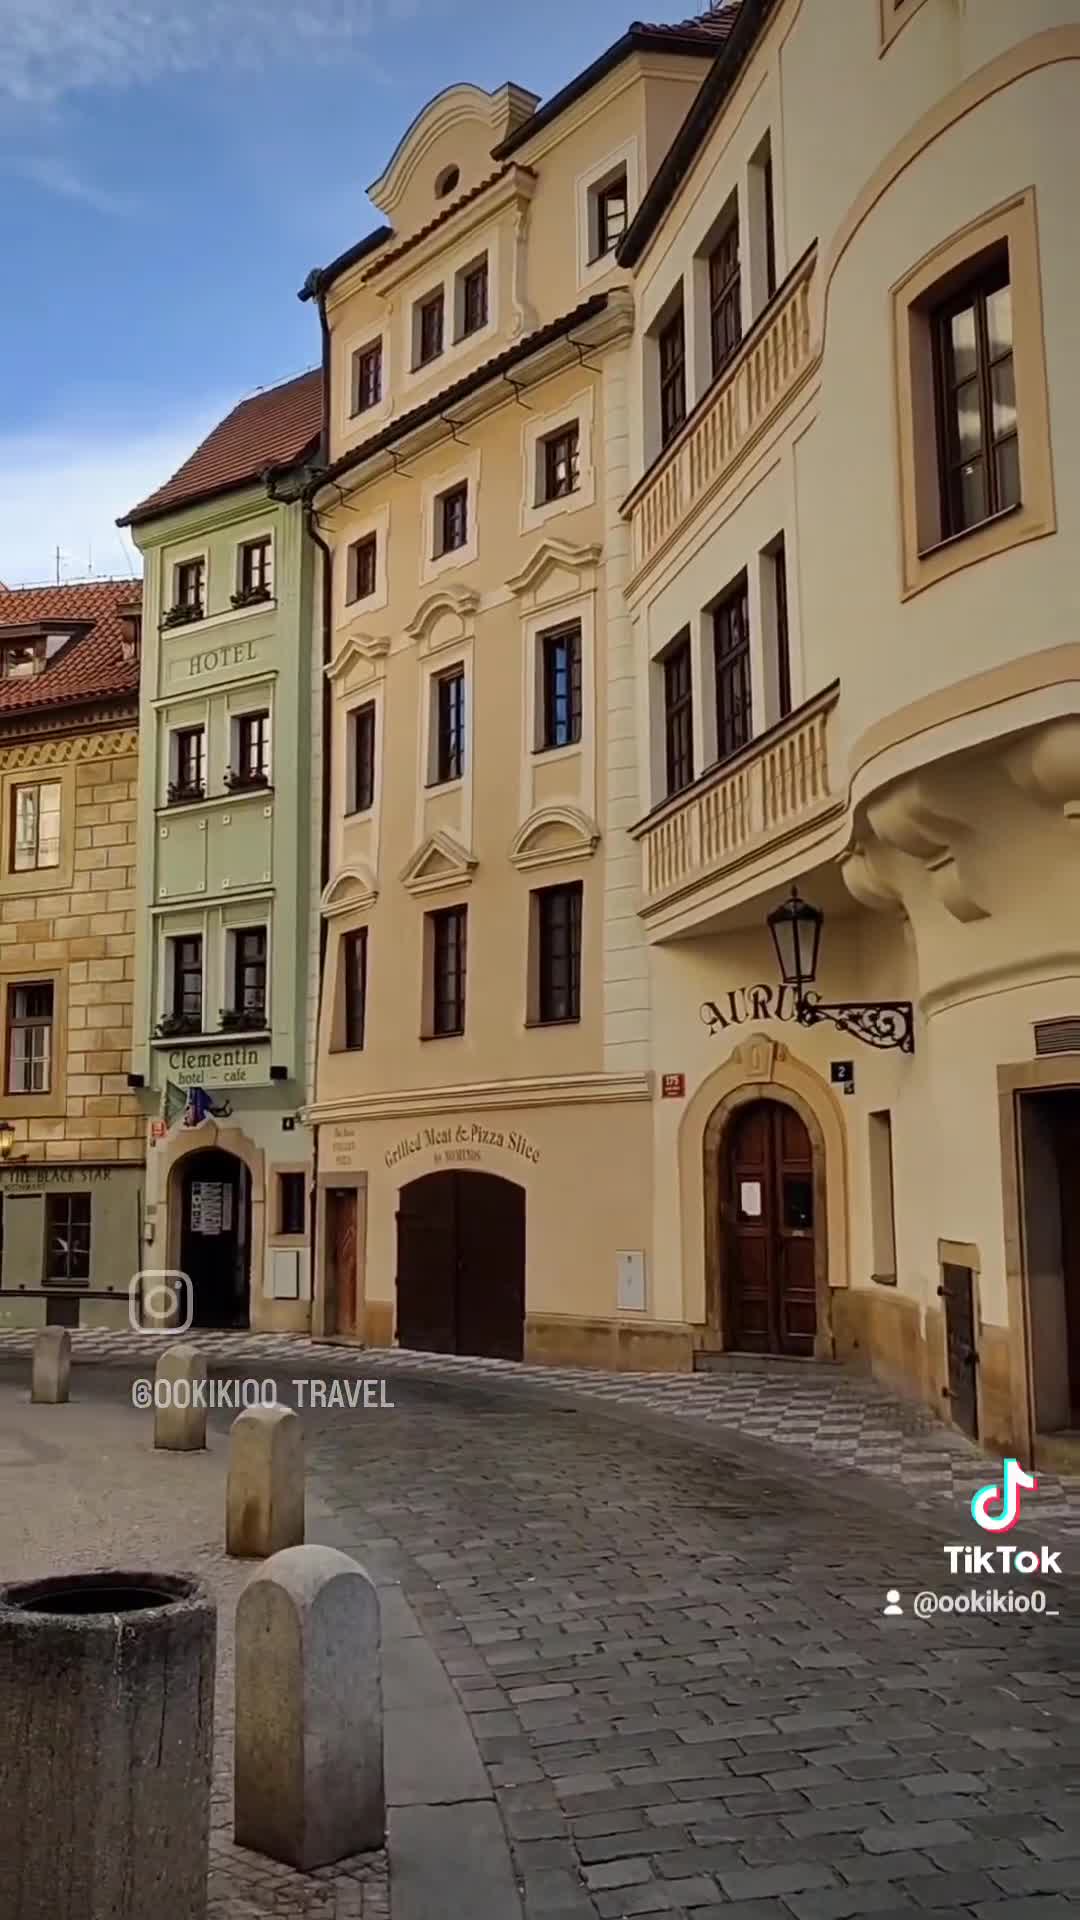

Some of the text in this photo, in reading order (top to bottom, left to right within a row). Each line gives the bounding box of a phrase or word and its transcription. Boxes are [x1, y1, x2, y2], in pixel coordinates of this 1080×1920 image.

[189, 640, 257, 676] HOTEL
[168, 1047, 259, 1070] Clementin
[178, 1070, 205, 1086] hotel
[838, 1065, 846, 1078] 2
[384, 1131, 421, 1169] Grilled
[423, 1127, 452, 1147] Meat
[455, 1124, 470, 1143] &
[471, 1123, 504, 1146] Pizza
[507, 1130, 541, 1165] Slice
[80, 1167, 112, 1182] STAR
